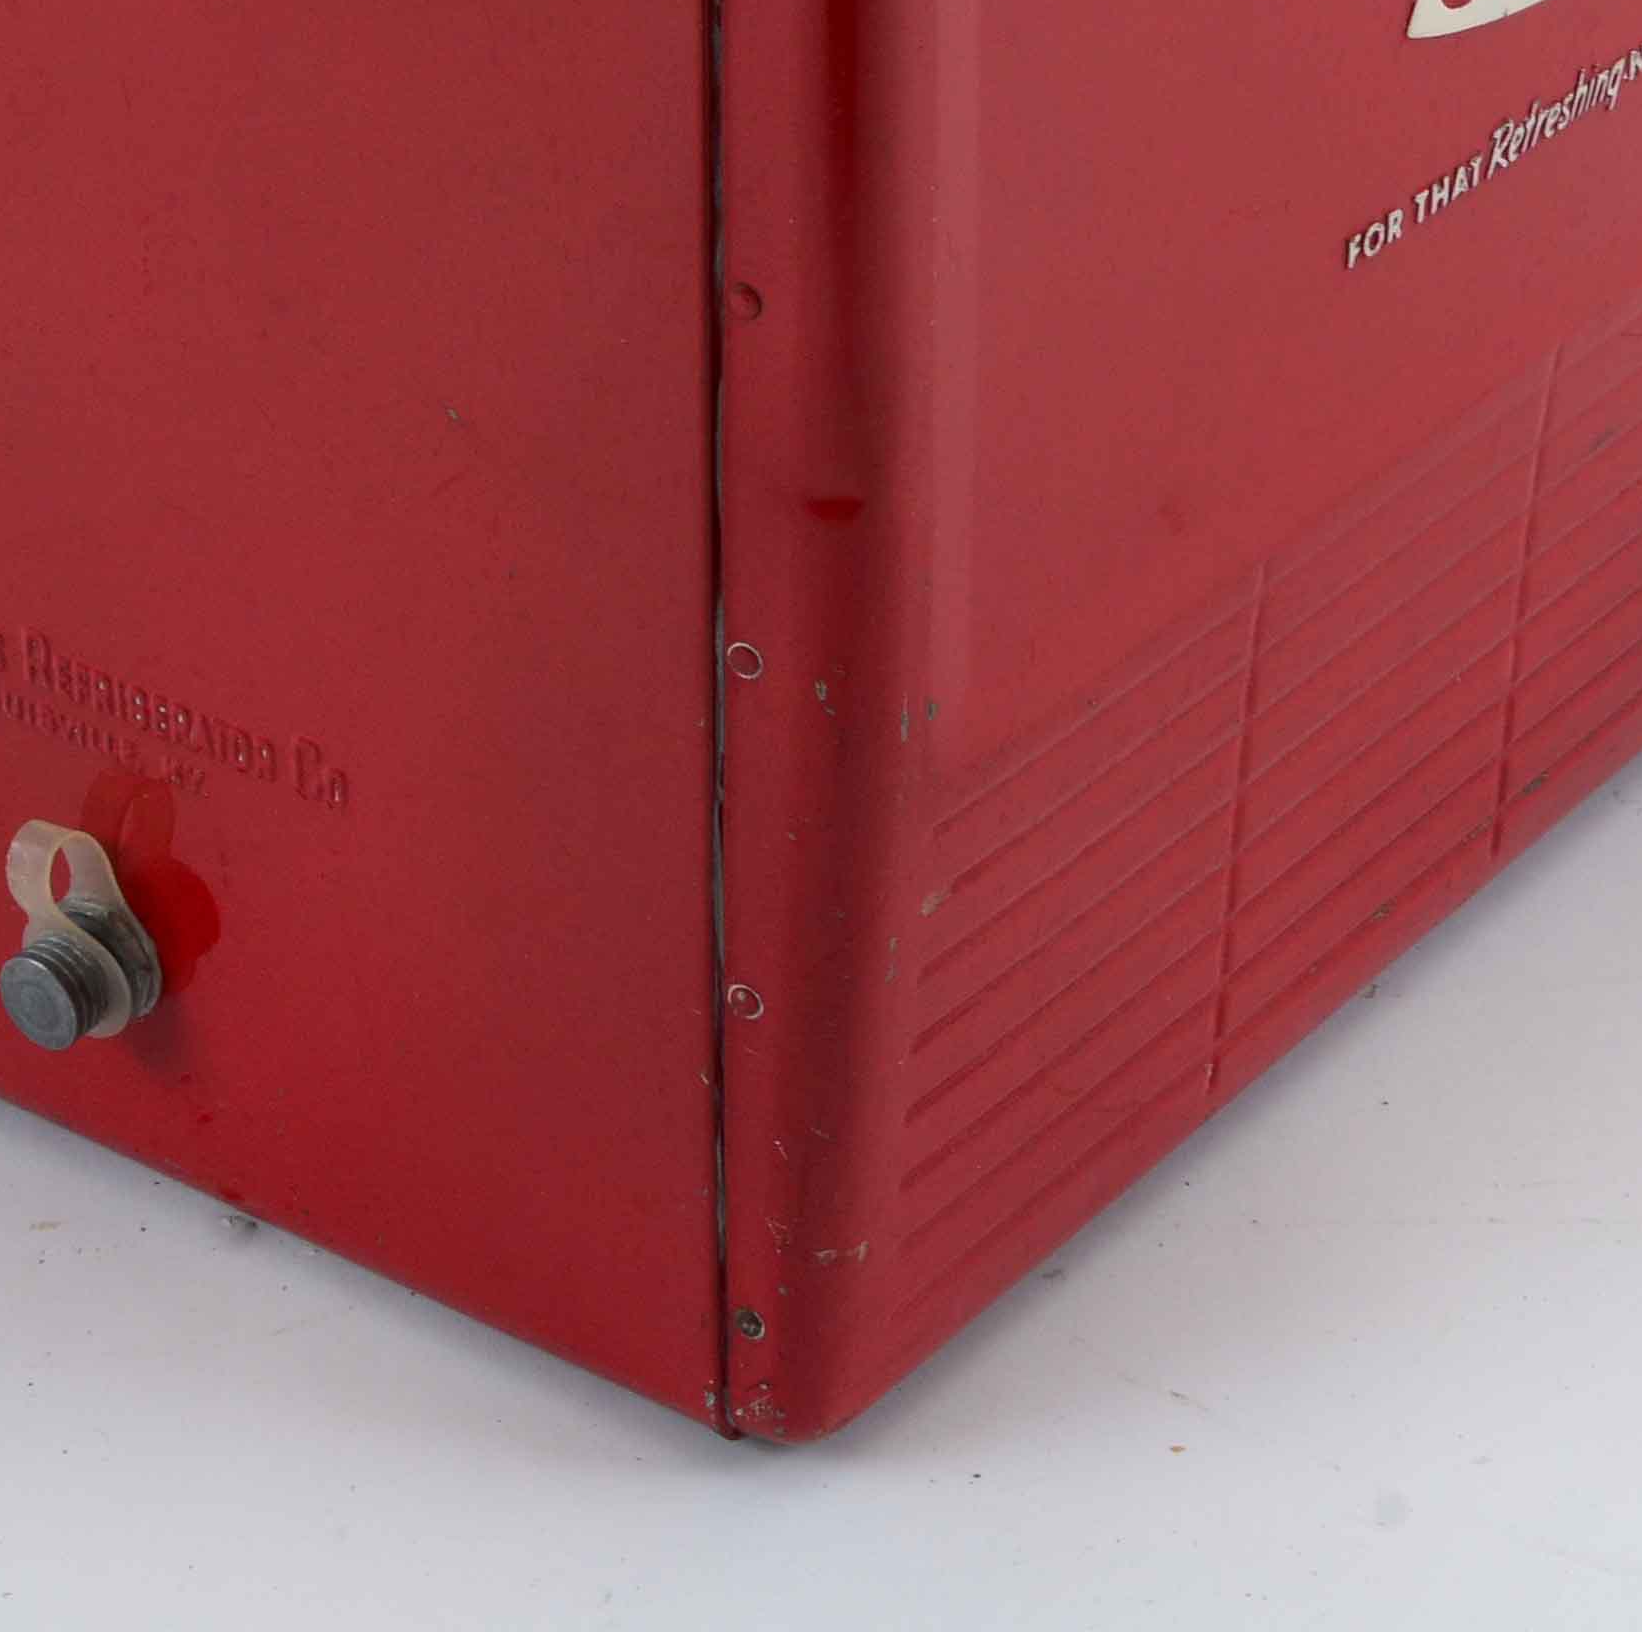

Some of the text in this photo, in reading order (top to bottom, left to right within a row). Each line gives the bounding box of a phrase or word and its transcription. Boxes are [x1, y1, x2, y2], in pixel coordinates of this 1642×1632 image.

[1345, 207, 1405, 269] FOR
[1413, 153, 1484, 224] THAT
[1487, 57, 1626, 180] Refreshing
